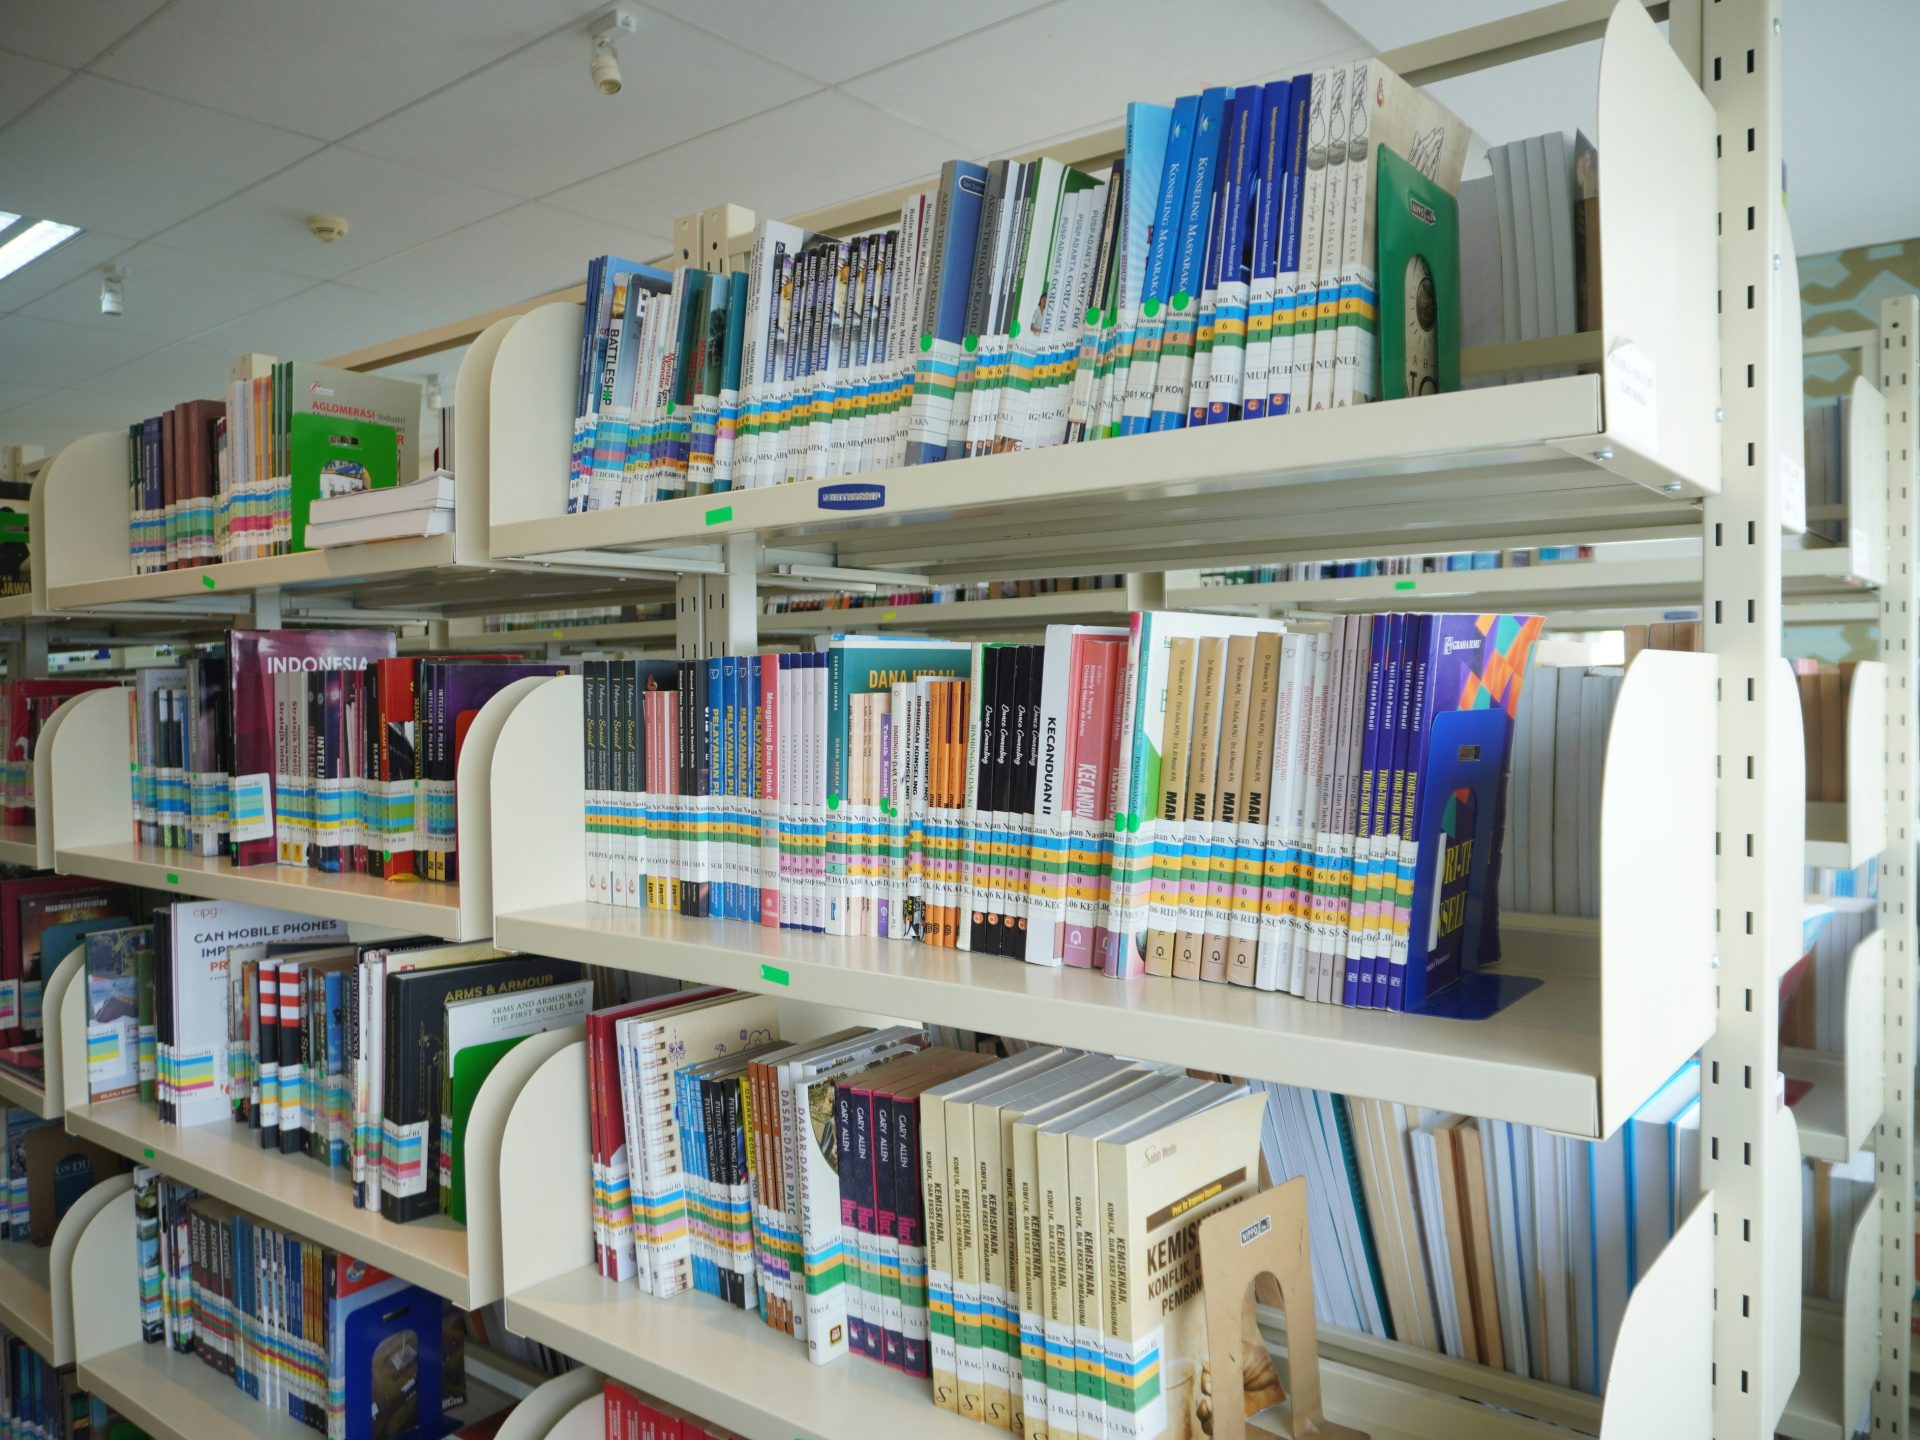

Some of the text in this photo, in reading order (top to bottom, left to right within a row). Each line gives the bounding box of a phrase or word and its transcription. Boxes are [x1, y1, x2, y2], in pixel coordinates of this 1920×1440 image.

[975, 229, 991, 289] TERHADAP
[1260, 241, 1268, 273] Masyarakat
[1287, 235, 1295, 267] Masyarakat
[1306, 226, 1315, 270] ADALAH
[1327, 222, 1335, 265] ADALAH
[1349, 218, 1357, 262] ADALAH
[917, 251, 928, 286] Refleksi
[911, 287, 922, 322] Seorang
[602, 329, 620, 406] BATTLESHP
[312, 401, 375, 419] AGLOMERASI
[268, 656, 368, 674] INDONESIA
[869, 670, 907, 688] DANA
[586, 718, 596, 748] Sosial
[598, 719, 608, 748] Sosial
[613, 720, 623, 750] Sosial
[626, 719, 636, 748] Sosial
[764, 693, 773, 742] Menggalang
[712, 709, 720, 777] PELAYANAN
[726, 705, 734, 778] PELAYANAN
[740, 707, 748, 780] PELAYANAN
[1043, 717, 1056, 802] KECANDUAN
[1360, 770, 1373, 813] TEORI-TEORI
[1405, 772, 1417, 816] TEORI-TEORI
[194, 920, 337, 944] CAN MOBILE PHONES
[445, 974, 554, 1002] ARMS ARMOUR
[516, 1000, 534, 1012] AND
[536, 992, 572, 1006] ARMOUR
[492, 998, 584, 1024] THE FIRST WORLD WAR
[780, 1090, 794, 1179] DASAR-DASAR
[840, 1100, 850, 1152] GARY ALLEN
[856, 1108, 867, 1160] GARY ALLEN
[879, 1110, 890, 1162] GARY ALLEN
[898, 1115, 909, 1167] GARY ALLEN
[730, 1135, 738, 1163] WONG
[797, 1107, 810, 1200] DASAR-DASAR
[960, 1189, 971, 1250] KEMISKINAN,
[988, 1194, 999, 1256] KEMISKINAN,
[1242, 1226, 1258, 1244] NIPPO
[1031, 1216, 1042, 1280] KEMISKINAN,
[1048, 1242, 1056, 1264] EKSES
[1055, 1224, 1067, 1289] KEMISKINAN,
[1084, 1231, 1095, 1297] KEMISKINAN,
[1116, 1237, 1127, 1304] KEMISKINAN,
[1049, 1266, 1058, 1320] PEMBANGUNAN
[1110, 1280, 1118, 1336] PEMBANGUNAN
